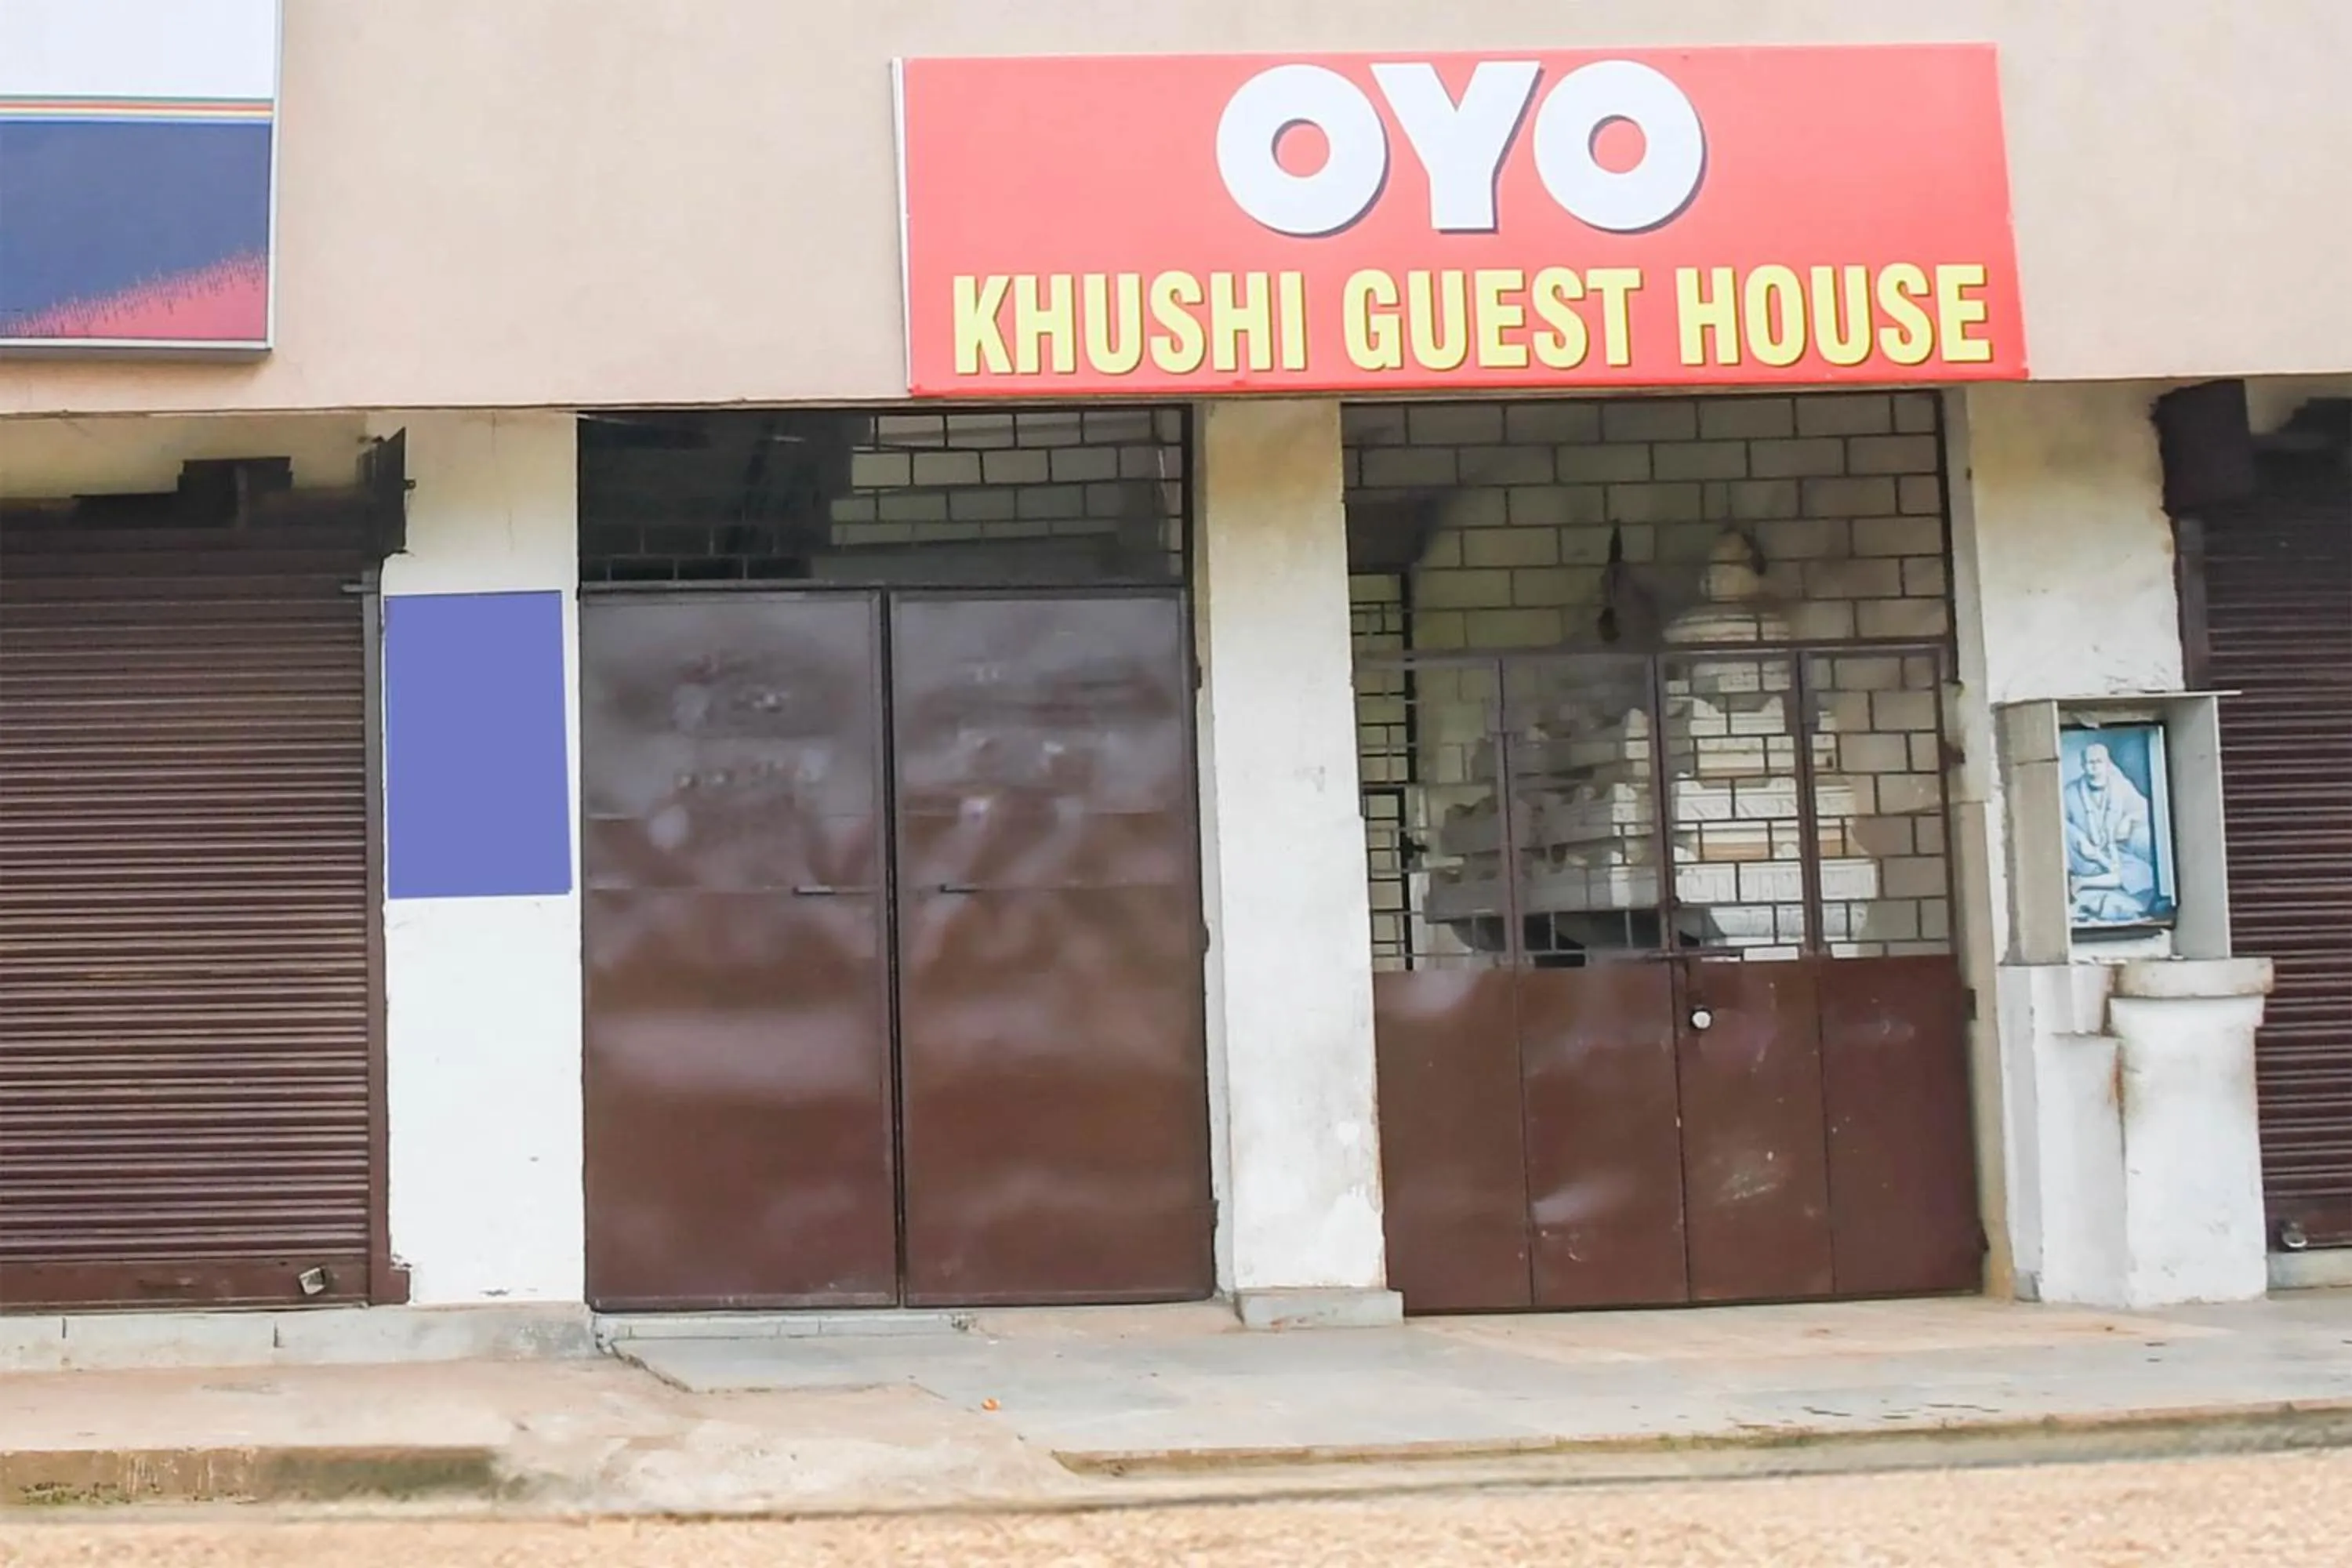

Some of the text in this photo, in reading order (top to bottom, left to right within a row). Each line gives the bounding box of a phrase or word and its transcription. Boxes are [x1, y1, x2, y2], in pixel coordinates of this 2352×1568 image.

[1215, 60, 1706, 236] OYO
[952, 263, 1994, 375] KHUSHI GUEST HOUSE
